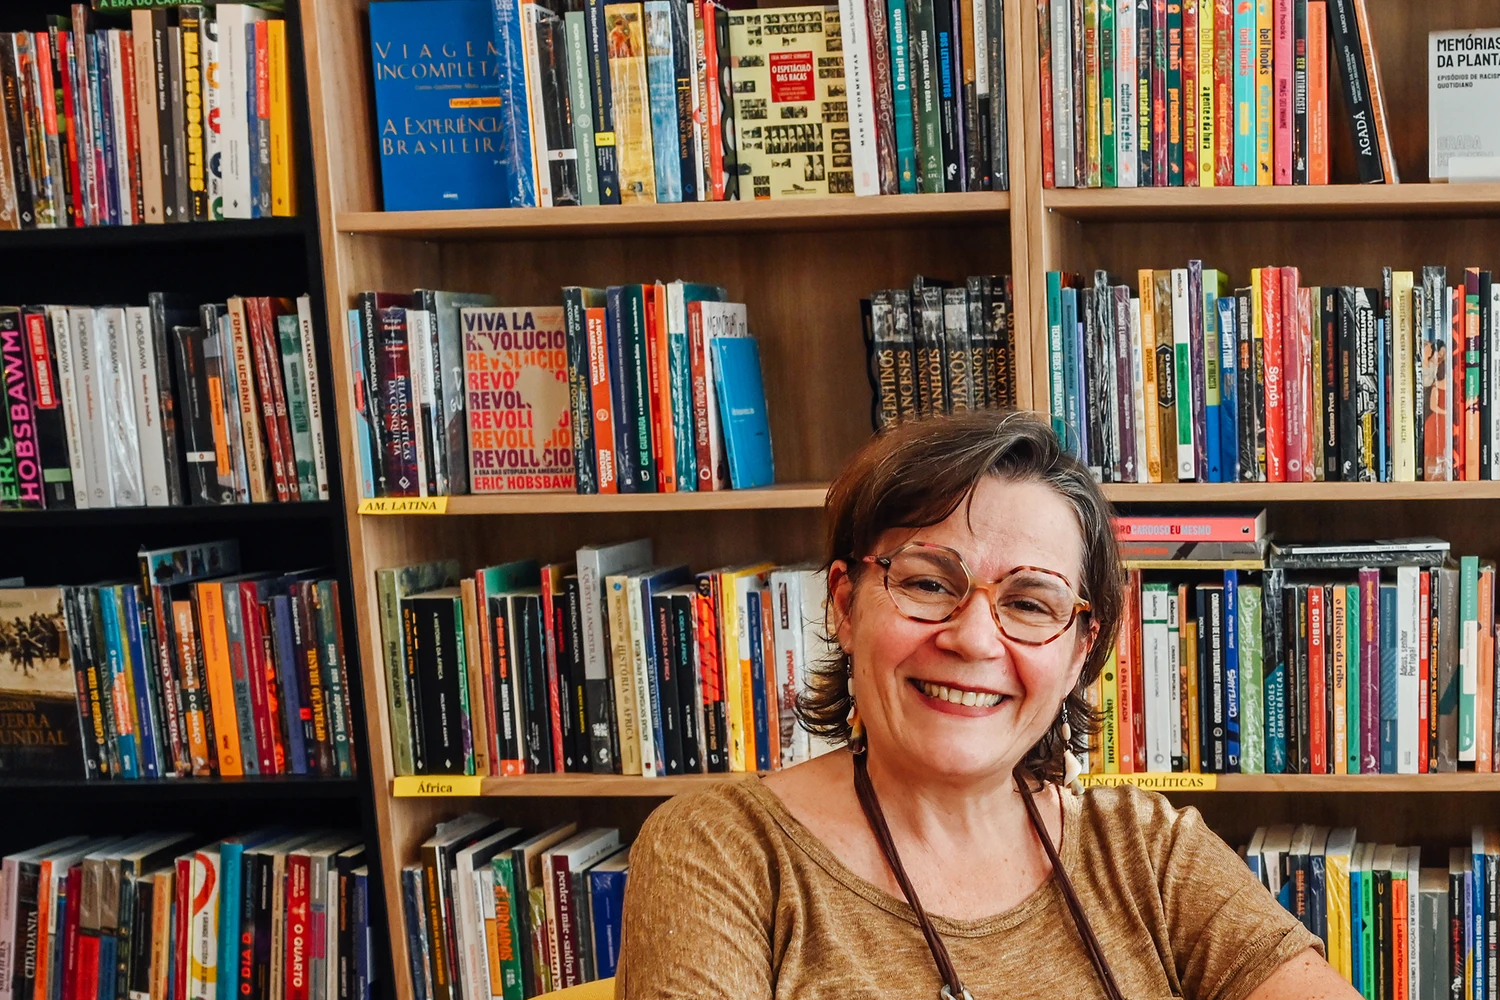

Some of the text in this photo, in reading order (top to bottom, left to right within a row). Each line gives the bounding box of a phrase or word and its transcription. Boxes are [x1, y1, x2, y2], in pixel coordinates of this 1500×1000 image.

[939, 32, 951, 98] DOS LETRAMENTOS
[1260, 28, 1271, 75] bell hooks
[1437, 55, 1453, 68] DA
[920, 31, 932, 112] HISTÓRIA GERAL DO BRASIL
[1437, 81, 1473, 89] QUOTIDIANO
[184, 32, 204, 192] MASTODONTES
[1354, 110, 1372, 156] AGADÁ
[463, 312, 535, 331] VIVA LA
[589, 319, 595, 330] NA
[595, 325, 603, 344] NOVA
[57, 320, 70, 373] HOBSBAWM
[77, 318, 90, 370] HOBSBAWM
[134, 316, 147, 369] HOBSBAWM
[232, 312, 251, 413] FOME NA UCRÂNIA
[303, 320, 319, 418] EXPULSANDO OS NAZISTAS
[591, 360, 599, 385] LATINA
[597, 346, 605, 382] ESQUERDA
[1268, 366, 1280, 408] Só nós
[0, 331, 41, 501] HOBSBAWM
[388, 380, 401, 455] DA CONQUISTA
[397, 375, 411, 459] RELATOS ASTECAS
[638, 417, 648, 465] CHE GUEVARA
[474, 474, 575, 490] ERIC HOBSBAW
[599, 450, 607, 487] MEDEIROS
[605, 450, 613, 481] JULIANO
[364, 501, 437, 512] AM. LATINA
[433, 618, 441, 646] HISTÓRIA
[1312, 595, 1320, 645] N. BOBBIO
[1335, 607, 1343, 649] feiticeiro
[435, 648, 442, 656] DA
[436, 658, 444, 680] ÁFRICA
[1335, 651, 1344, 663] da
[1336, 665, 1344, 688] tribo
[1268, 684, 1276, 737] TRANSIÇÕES
[1276, 671, 1284, 738] DEMOCRÁTICAS
[417, 780, 452, 793] África
[1137, 776, 1204, 788] POLÍTICAS
[557, 871, 568, 903] perder
[559, 913, 570, 933] mãe
[293, 924, 303, 987] O QUARTO
[561, 940, 573, 974] saidiya
